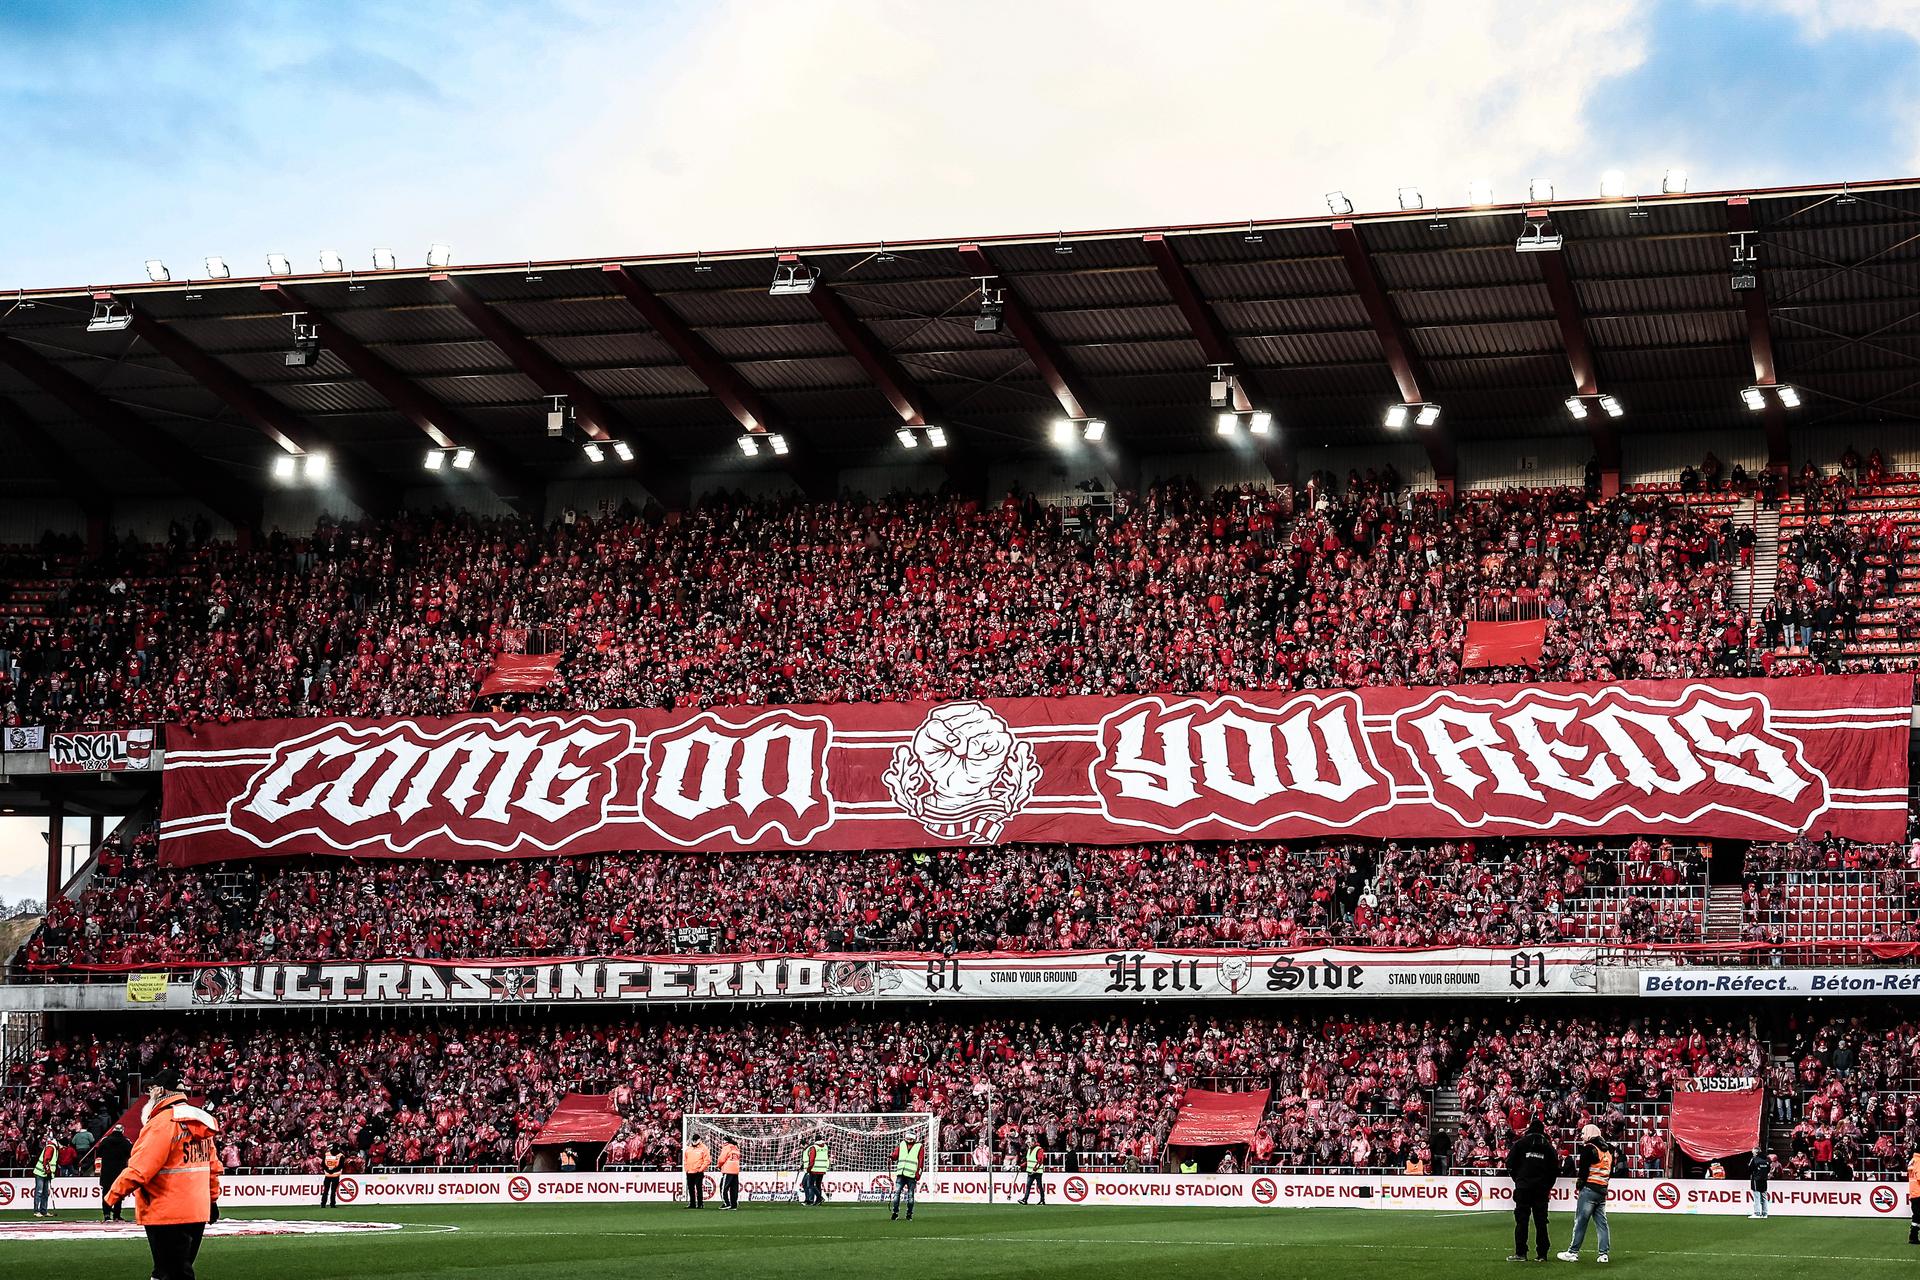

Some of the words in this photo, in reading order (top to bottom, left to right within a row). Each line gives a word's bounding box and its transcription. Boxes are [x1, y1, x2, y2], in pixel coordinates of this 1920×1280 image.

[53, 734, 127, 763] RSCL
[241, 726, 621, 825] COME
[651, 723, 819, 820] ON
[1105, 703, 1379, 808] YOU
[1407, 698, 1811, 803] REDS
[926, 959, 963, 993] 81
[990, 972, 1018, 983] STAND
[1019, 972, 1042, 983] YOUR
[1043, 971, 1078, 983] GROUND
[1105, 953, 1203, 993] Hell
[1266, 956, 1364, 992] Side
[1509, 951, 1550, 989] 81
[240, 963, 492, 1000] ULTRAS
[534, 958, 827, 999] INFERNO
[1388, 973, 1418, 985] STAND
[1419, 973, 1442, 985] YOUR
[1444, 972, 1480, 985] GROUND
[1646, 975, 1787, 991] Béton-Réfect
[21, 1187, 88, 1199] RKVRIJ
[365, 1183, 434, 1196] ROOKVRIJ
[438, 1182, 500, 1195] STADION
[538, 1182, 584, 1194] STADE
[1095, 1183, 1171, 1196] ROOKVRIJ
[1175, 1184, 1243, 1197] STADION
[1284, 1185, 1335, 1198] STADE
[1687, 1189, 1741, 1203] STADE
